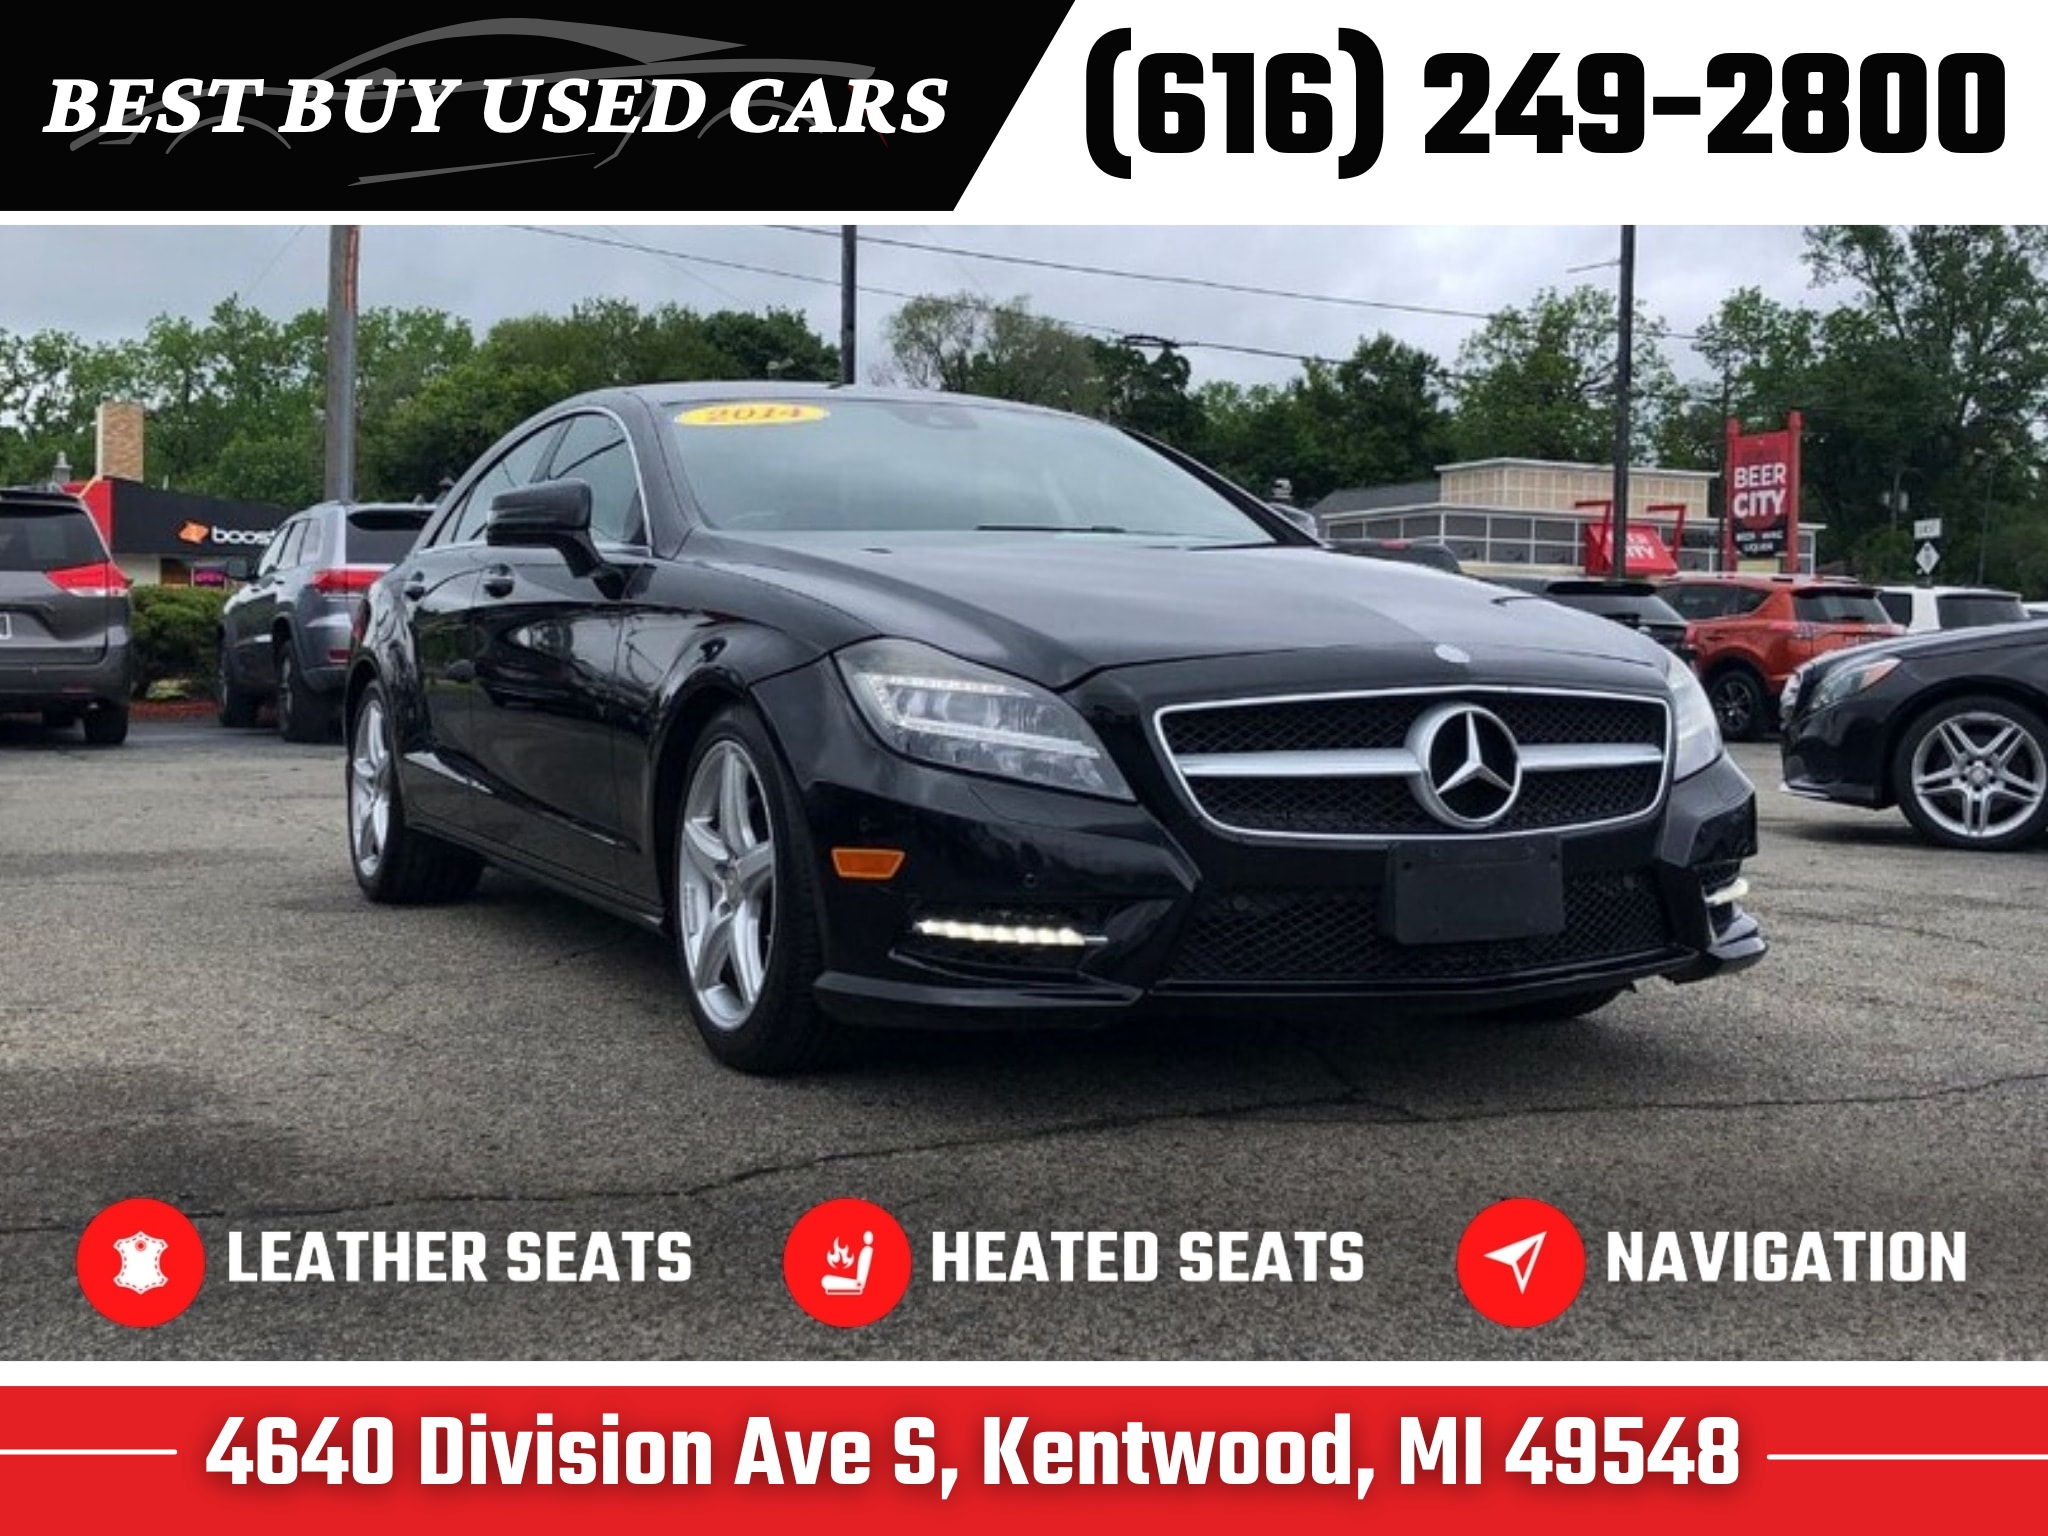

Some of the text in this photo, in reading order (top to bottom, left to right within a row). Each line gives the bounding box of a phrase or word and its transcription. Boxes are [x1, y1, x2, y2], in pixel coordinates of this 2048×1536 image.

[706, 406, 802, 422] 2014
[1734, 462, 1787, 489] BEER
[1733, 488, 1786, 517] CITY
